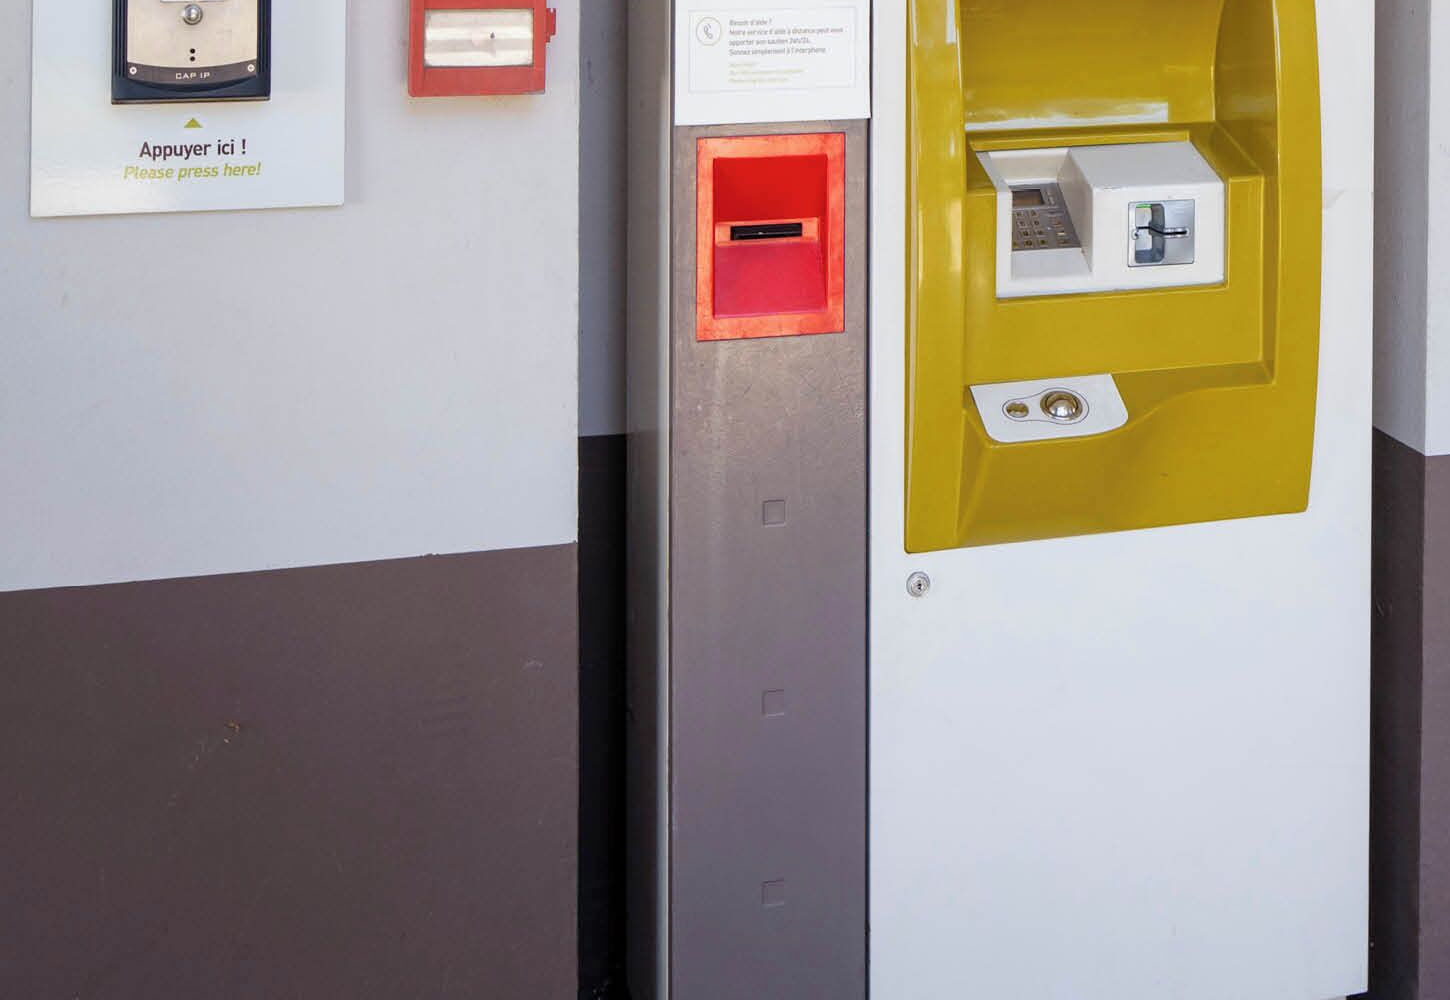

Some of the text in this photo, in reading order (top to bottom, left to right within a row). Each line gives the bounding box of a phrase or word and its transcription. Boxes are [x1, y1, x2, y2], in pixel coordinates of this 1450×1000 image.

[176, 71, 210, 80] CAP IP
[139, 139, 246, 160] Appuyer ici !
[124, 163, 261, 182] Please press here!
